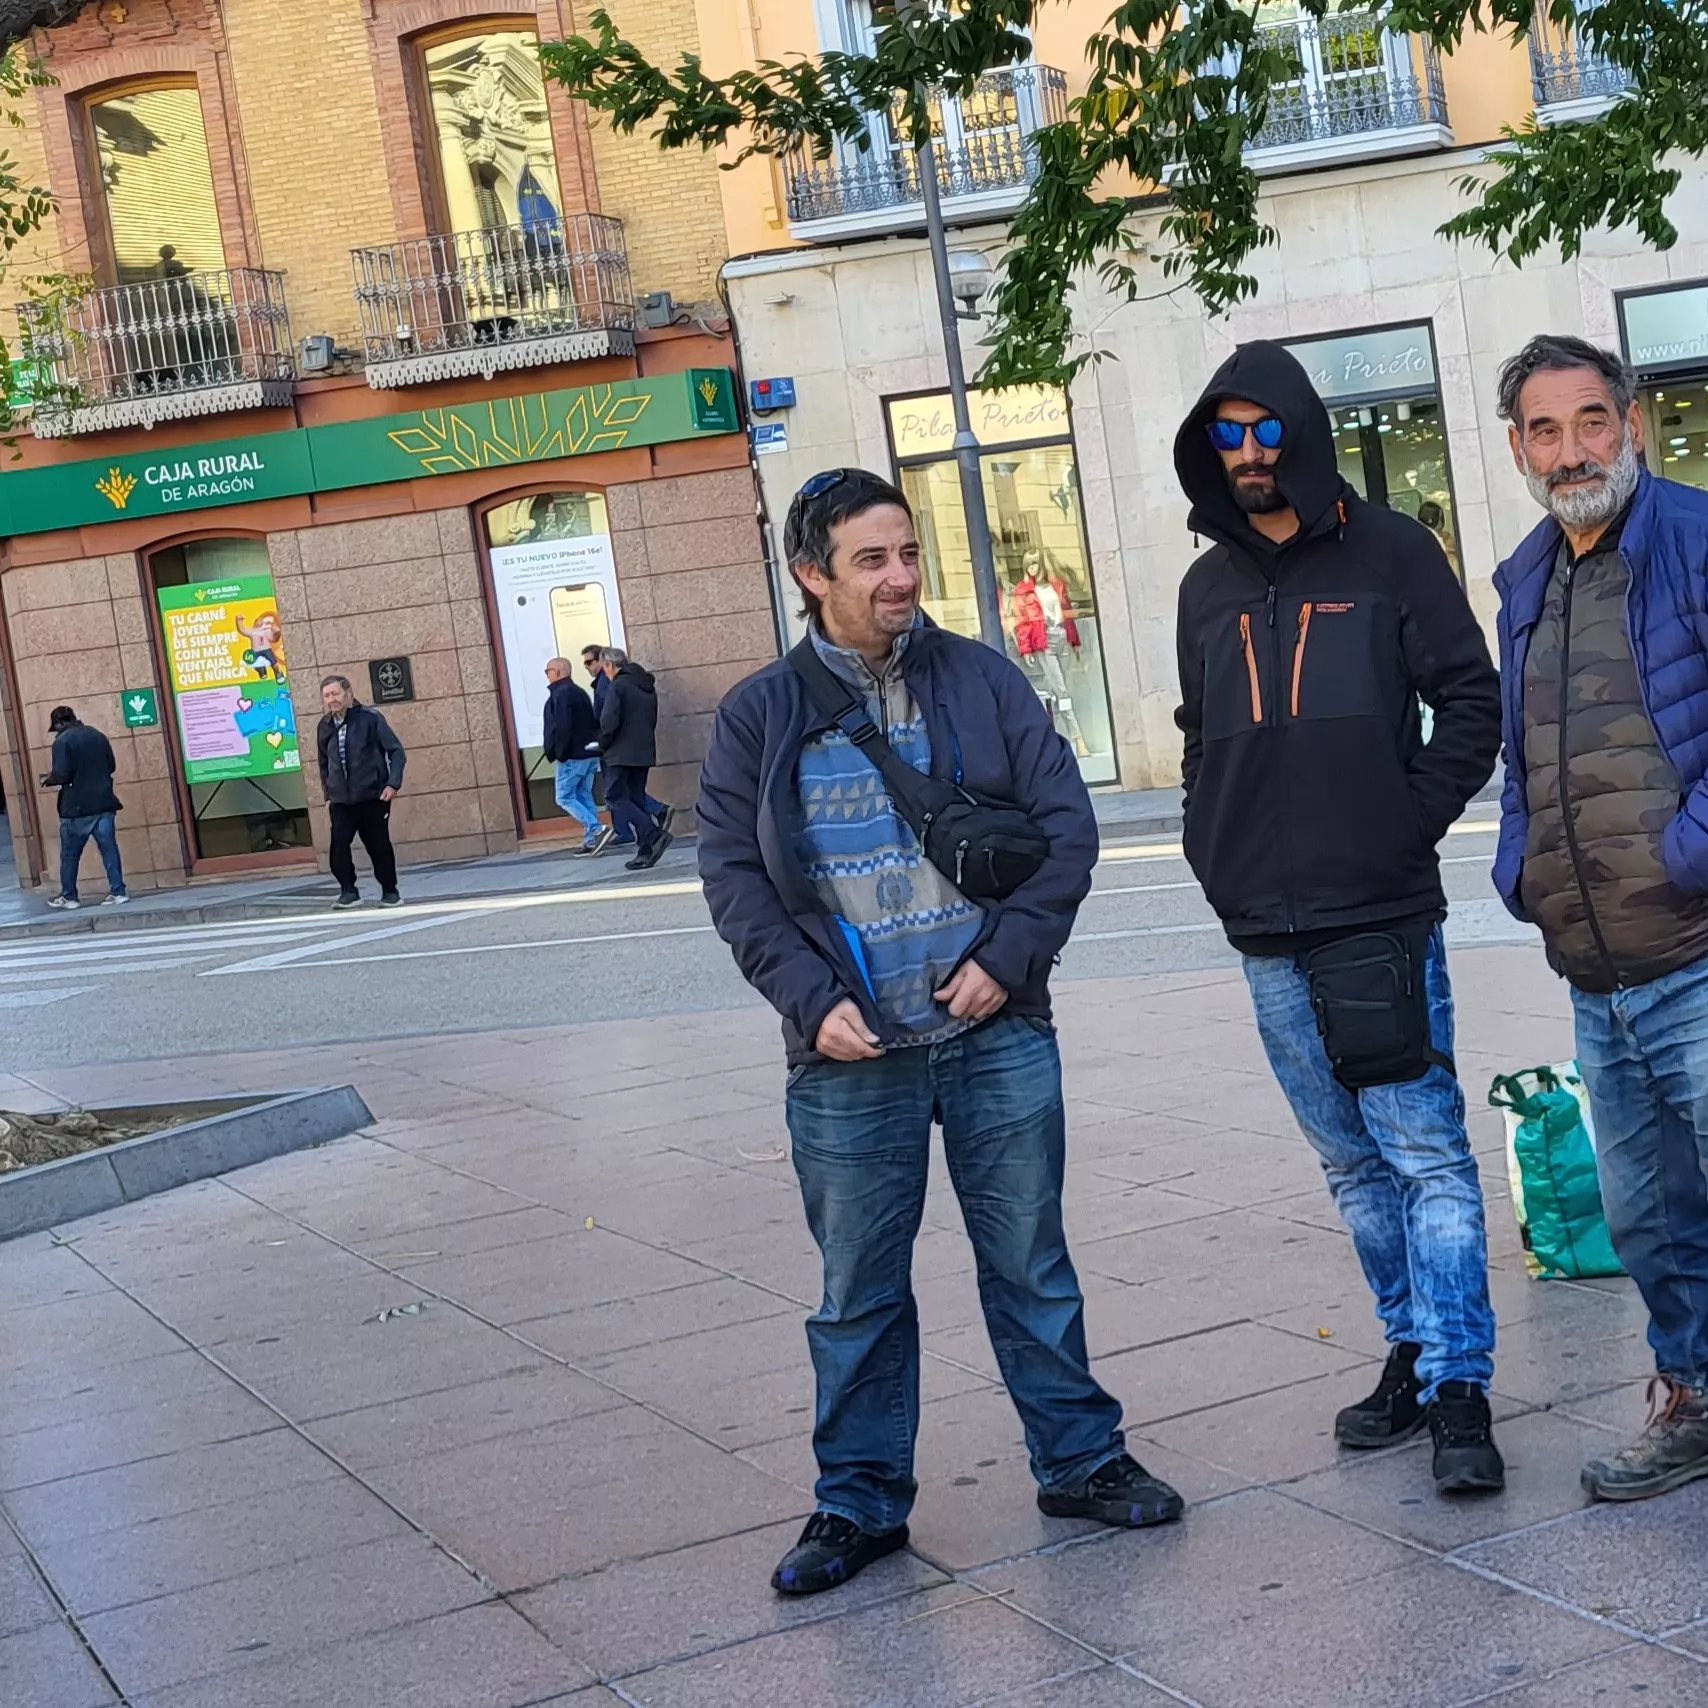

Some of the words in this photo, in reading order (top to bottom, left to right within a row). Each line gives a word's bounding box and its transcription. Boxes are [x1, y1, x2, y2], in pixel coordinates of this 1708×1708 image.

[1343, 346, 1428, 381] Prieto
[900, 410, 957, 443] Pila
[981, 396, 1061, 431] Prieto
[144, 461, 195, 485] CAJA
[197, 451, 265, 478] RURAL
[161, 487, 183, 503] DE
[187, 475, 255, 500] ARAGÓN
[516, 554, 528, 564] TU
[528, 552, 558, 563] NUEVO
[169, 614, 185, 625] TU
[186, 606, 226, 624] CARNÉ
[174, 638, 188, 650] DE
[190, 631, 239, 647] SIEMPRE
[175, 649, 201, 661] CON
[203, 643, 229, 658] MÁS
[176, 655, 233, 674] VENTAJAS
[178, 673, 203, 685] QUE
[204, 666, 248, 681] NUNCA
